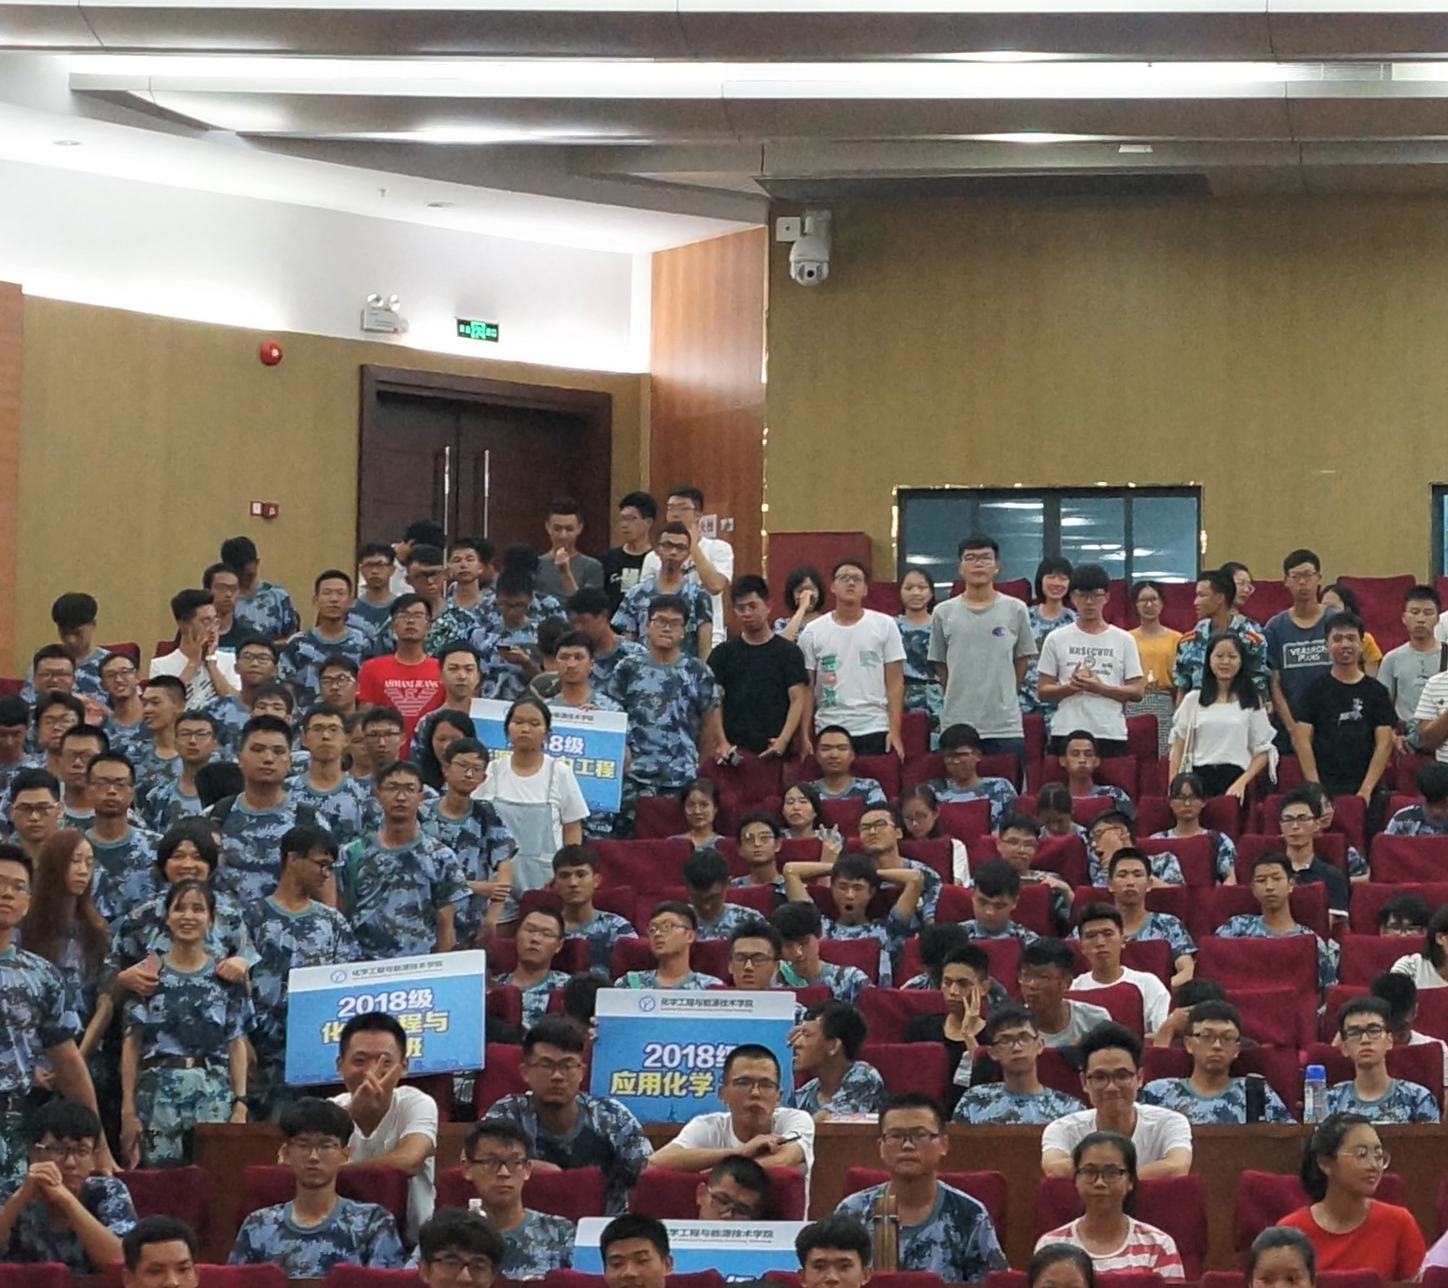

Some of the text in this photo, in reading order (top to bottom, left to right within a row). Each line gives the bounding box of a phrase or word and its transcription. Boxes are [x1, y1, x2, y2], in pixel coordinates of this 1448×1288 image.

[337, 988, 434, 1017] 2018级
[321, 1010, 449, 1043] 化程与
[666, 1228, 774, 1239] 学工程与能源技术学院
